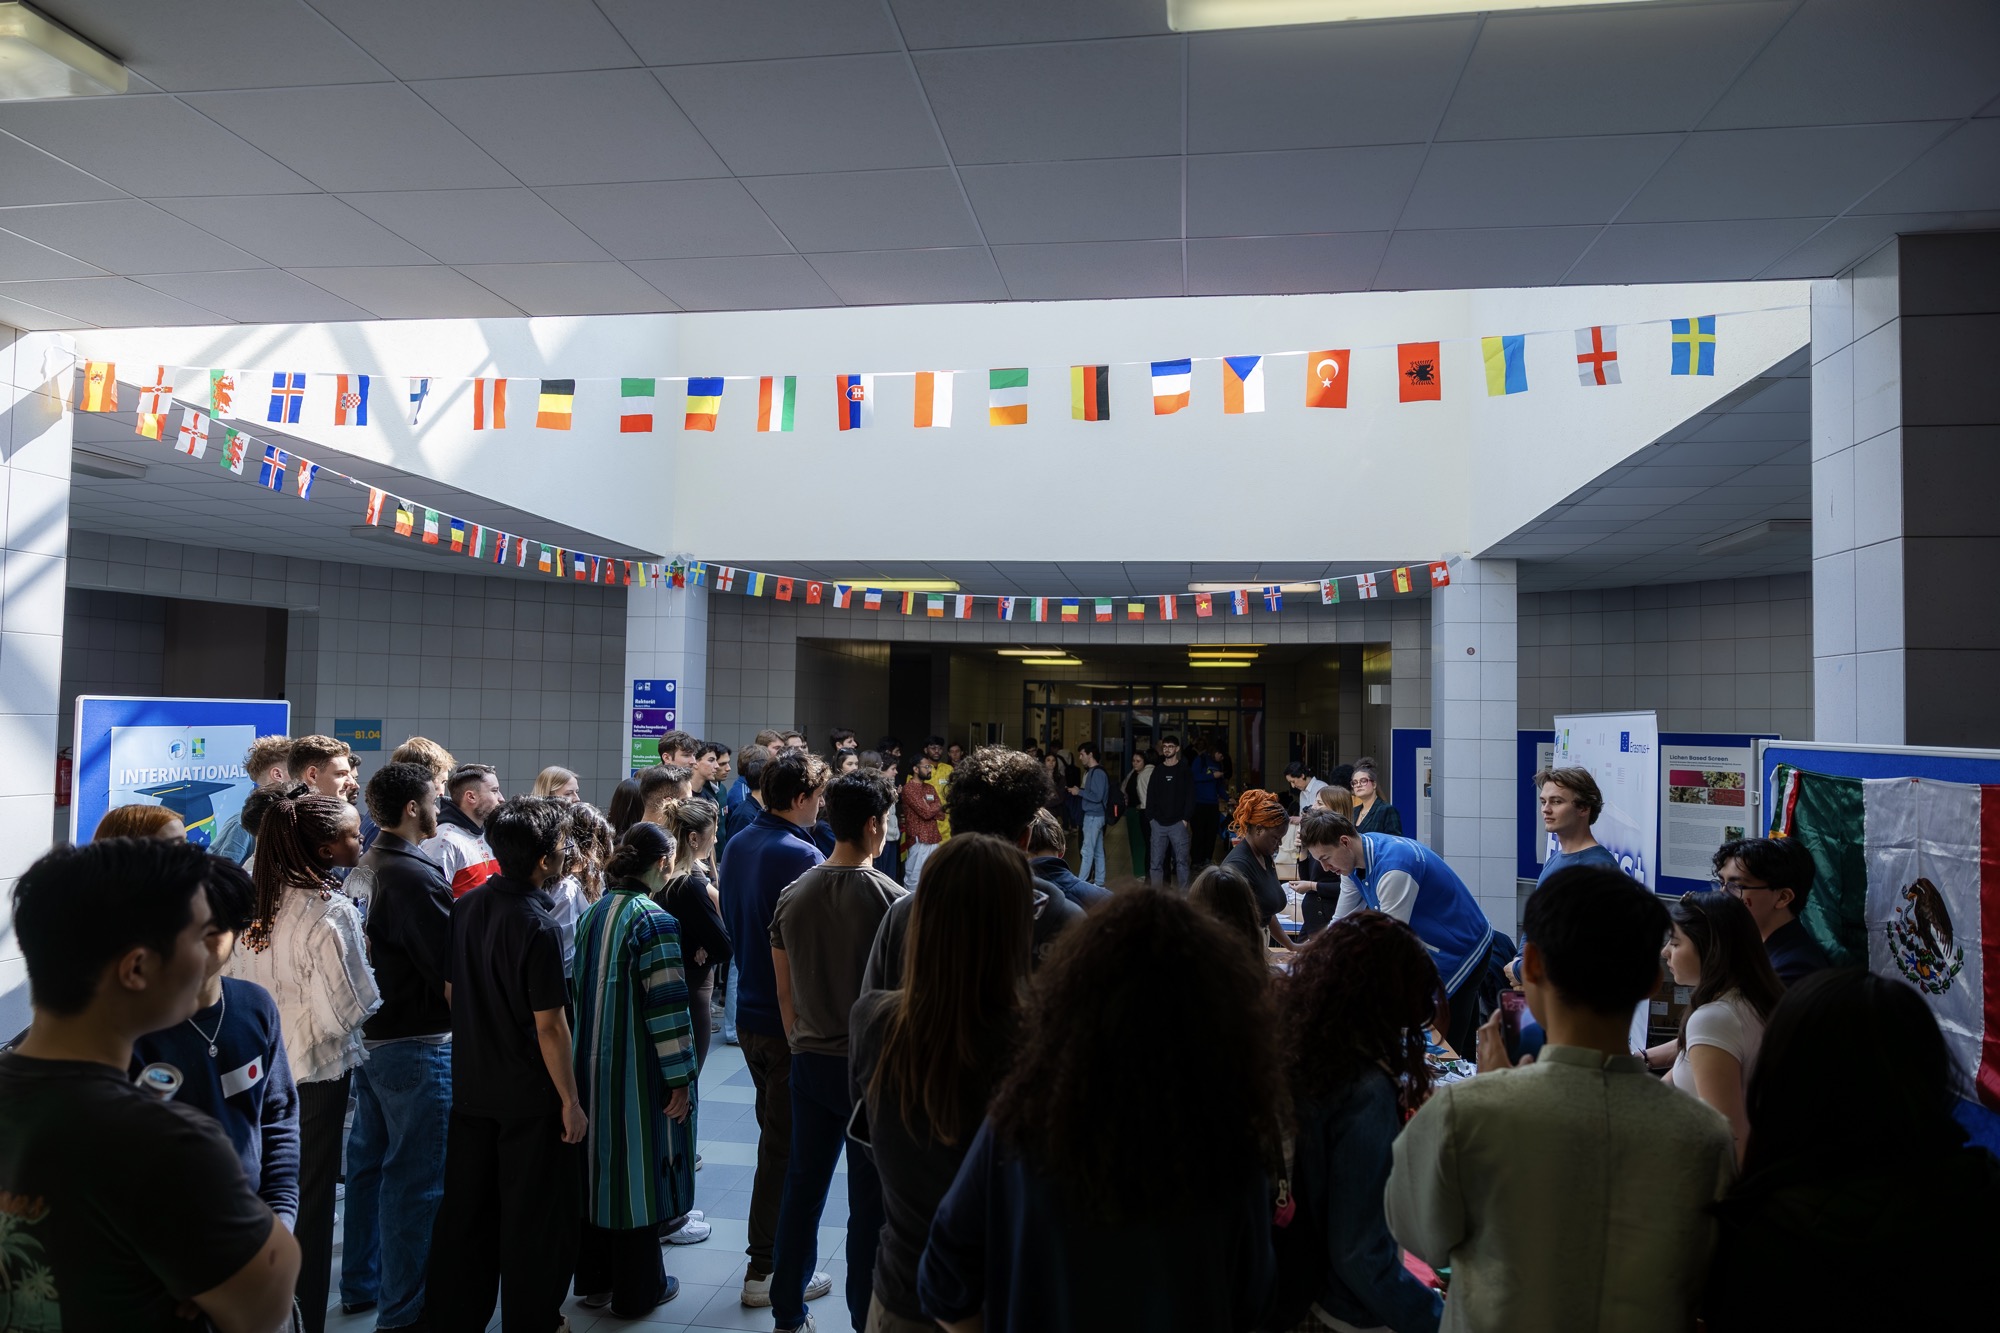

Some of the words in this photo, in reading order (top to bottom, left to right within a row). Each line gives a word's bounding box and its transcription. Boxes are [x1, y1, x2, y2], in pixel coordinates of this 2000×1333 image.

[355, 730, 380, 739] B1.04
[119, 764, 248, 785] INTERNATIONAL
[1502, 1001, 1525, 1011] 12:0
